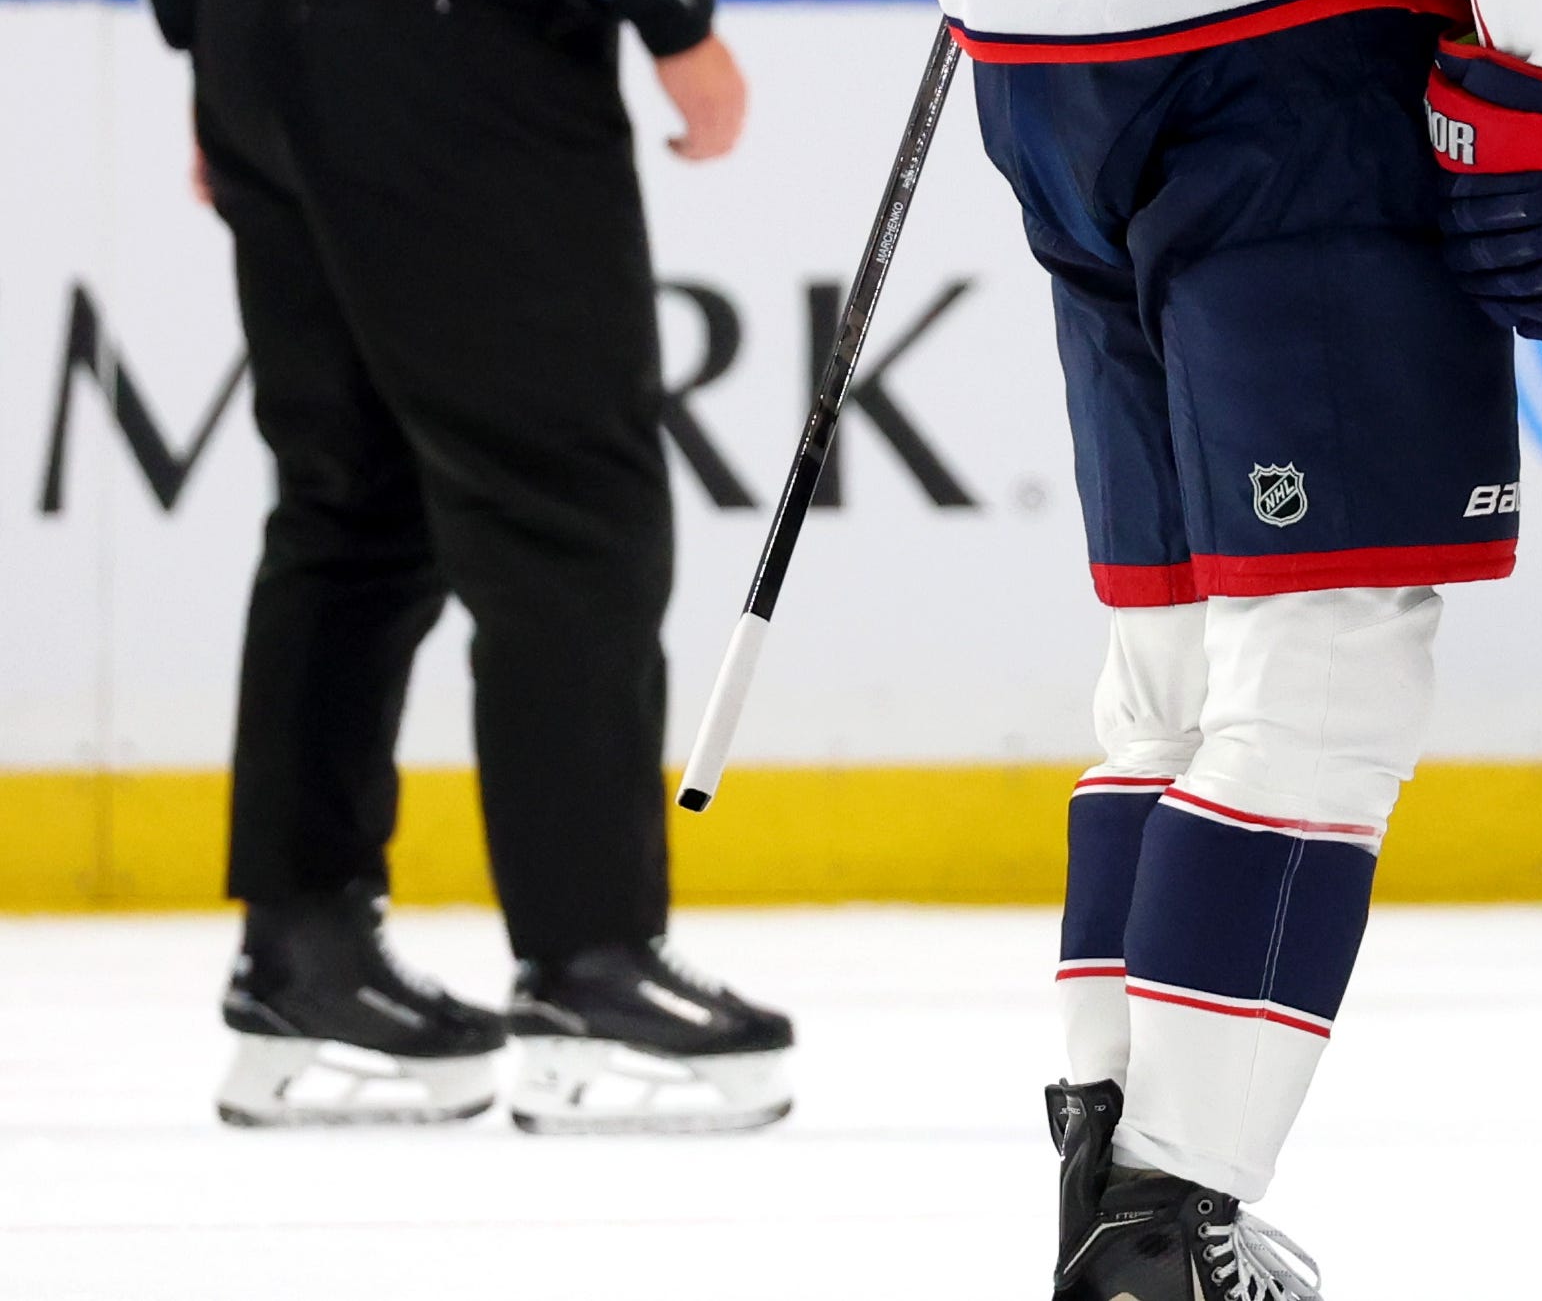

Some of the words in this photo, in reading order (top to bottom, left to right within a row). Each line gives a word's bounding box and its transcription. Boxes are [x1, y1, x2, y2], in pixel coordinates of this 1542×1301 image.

[876, 201, 904, 263] MARCHENKO
[37, 274, 1002, 516] MRK
[1264, 479, 1297, 513] NHL
